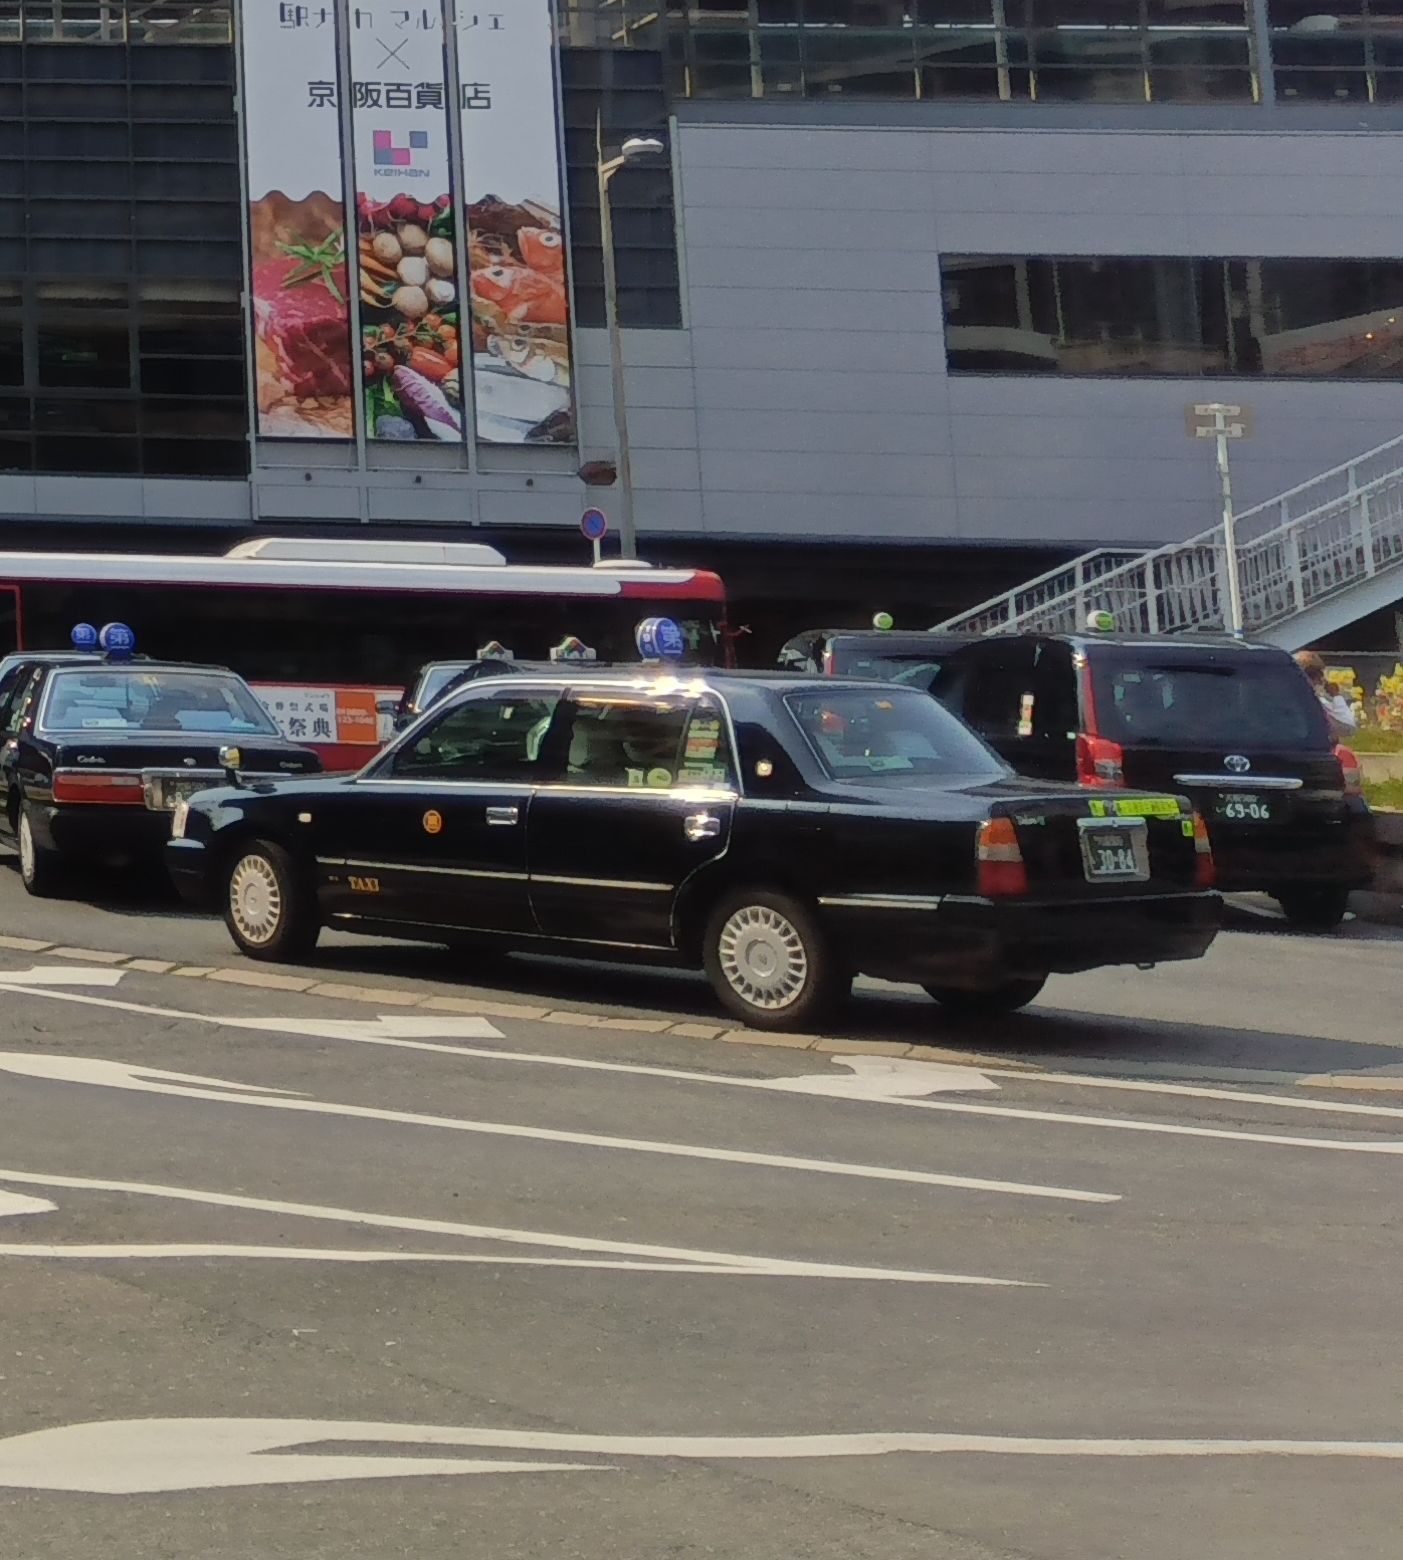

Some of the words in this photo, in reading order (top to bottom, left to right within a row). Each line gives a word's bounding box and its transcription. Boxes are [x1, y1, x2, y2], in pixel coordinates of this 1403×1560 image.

[307, 80, 492, 109] 京阪百貨店
[347, 876, 380, 892] TAXI
